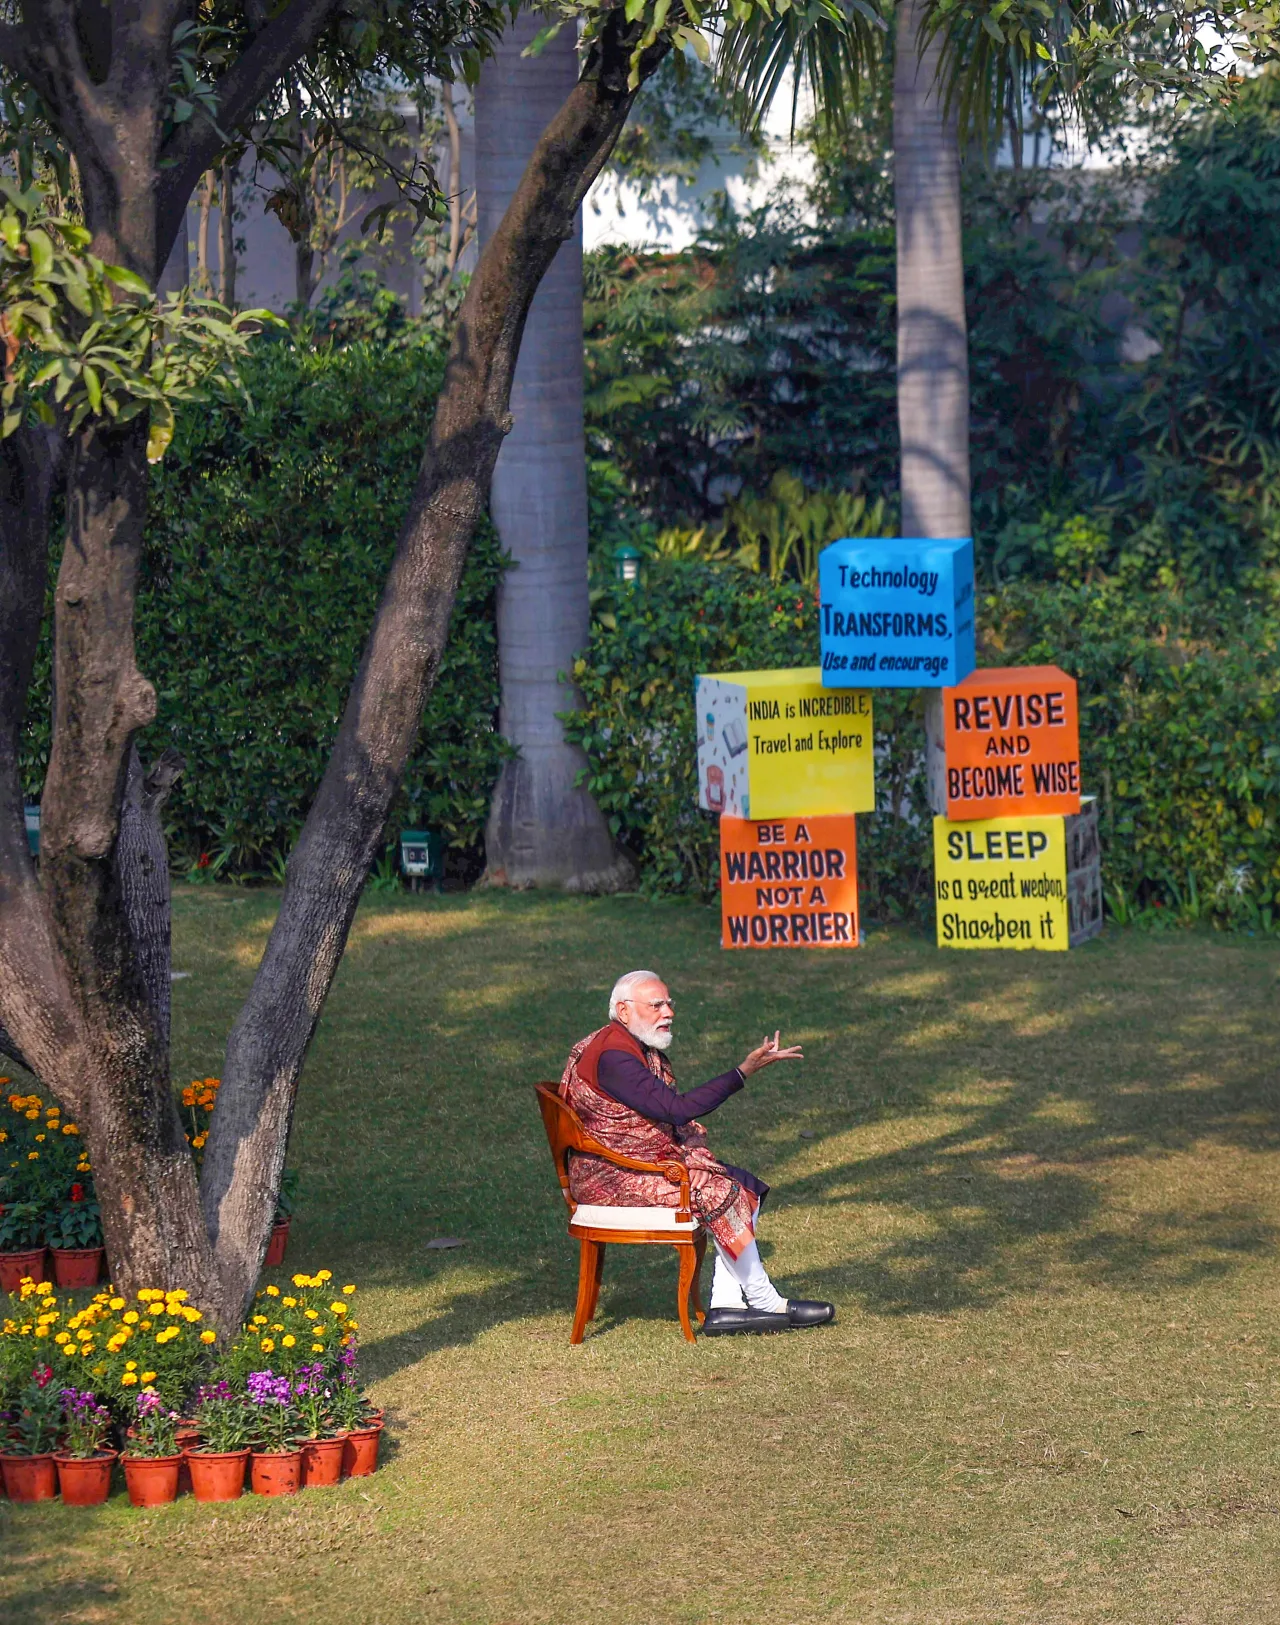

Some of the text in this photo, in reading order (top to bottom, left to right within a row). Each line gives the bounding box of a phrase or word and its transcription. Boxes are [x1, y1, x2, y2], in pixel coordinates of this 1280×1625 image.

[839, 564, 939, 597] Technology
[823, 652, 949, 678] Use and encourage
[749, 696, 870, 721] INDIA is INCREDIBLE,
[953, 692, 1067, 732] REVISE
[753, 730, 863, 755] Travel and Explore
[985, 735, 1032, 758] AND
[948, 761, 1080, 801] BECOME WISE
[757, 824, 812, 845] BE A
[947, 830, 1048, 862] SLEEP
[725, 849, 846, 884] WARRIOR
[756, 886, 828, 909] NOT A
[952, 880, 963, 900] a
[968, 872, 1016, 900] great
[727, 912, 857, 946] WORRIER!
[942, 912, 1055, 942] Sharpen it
